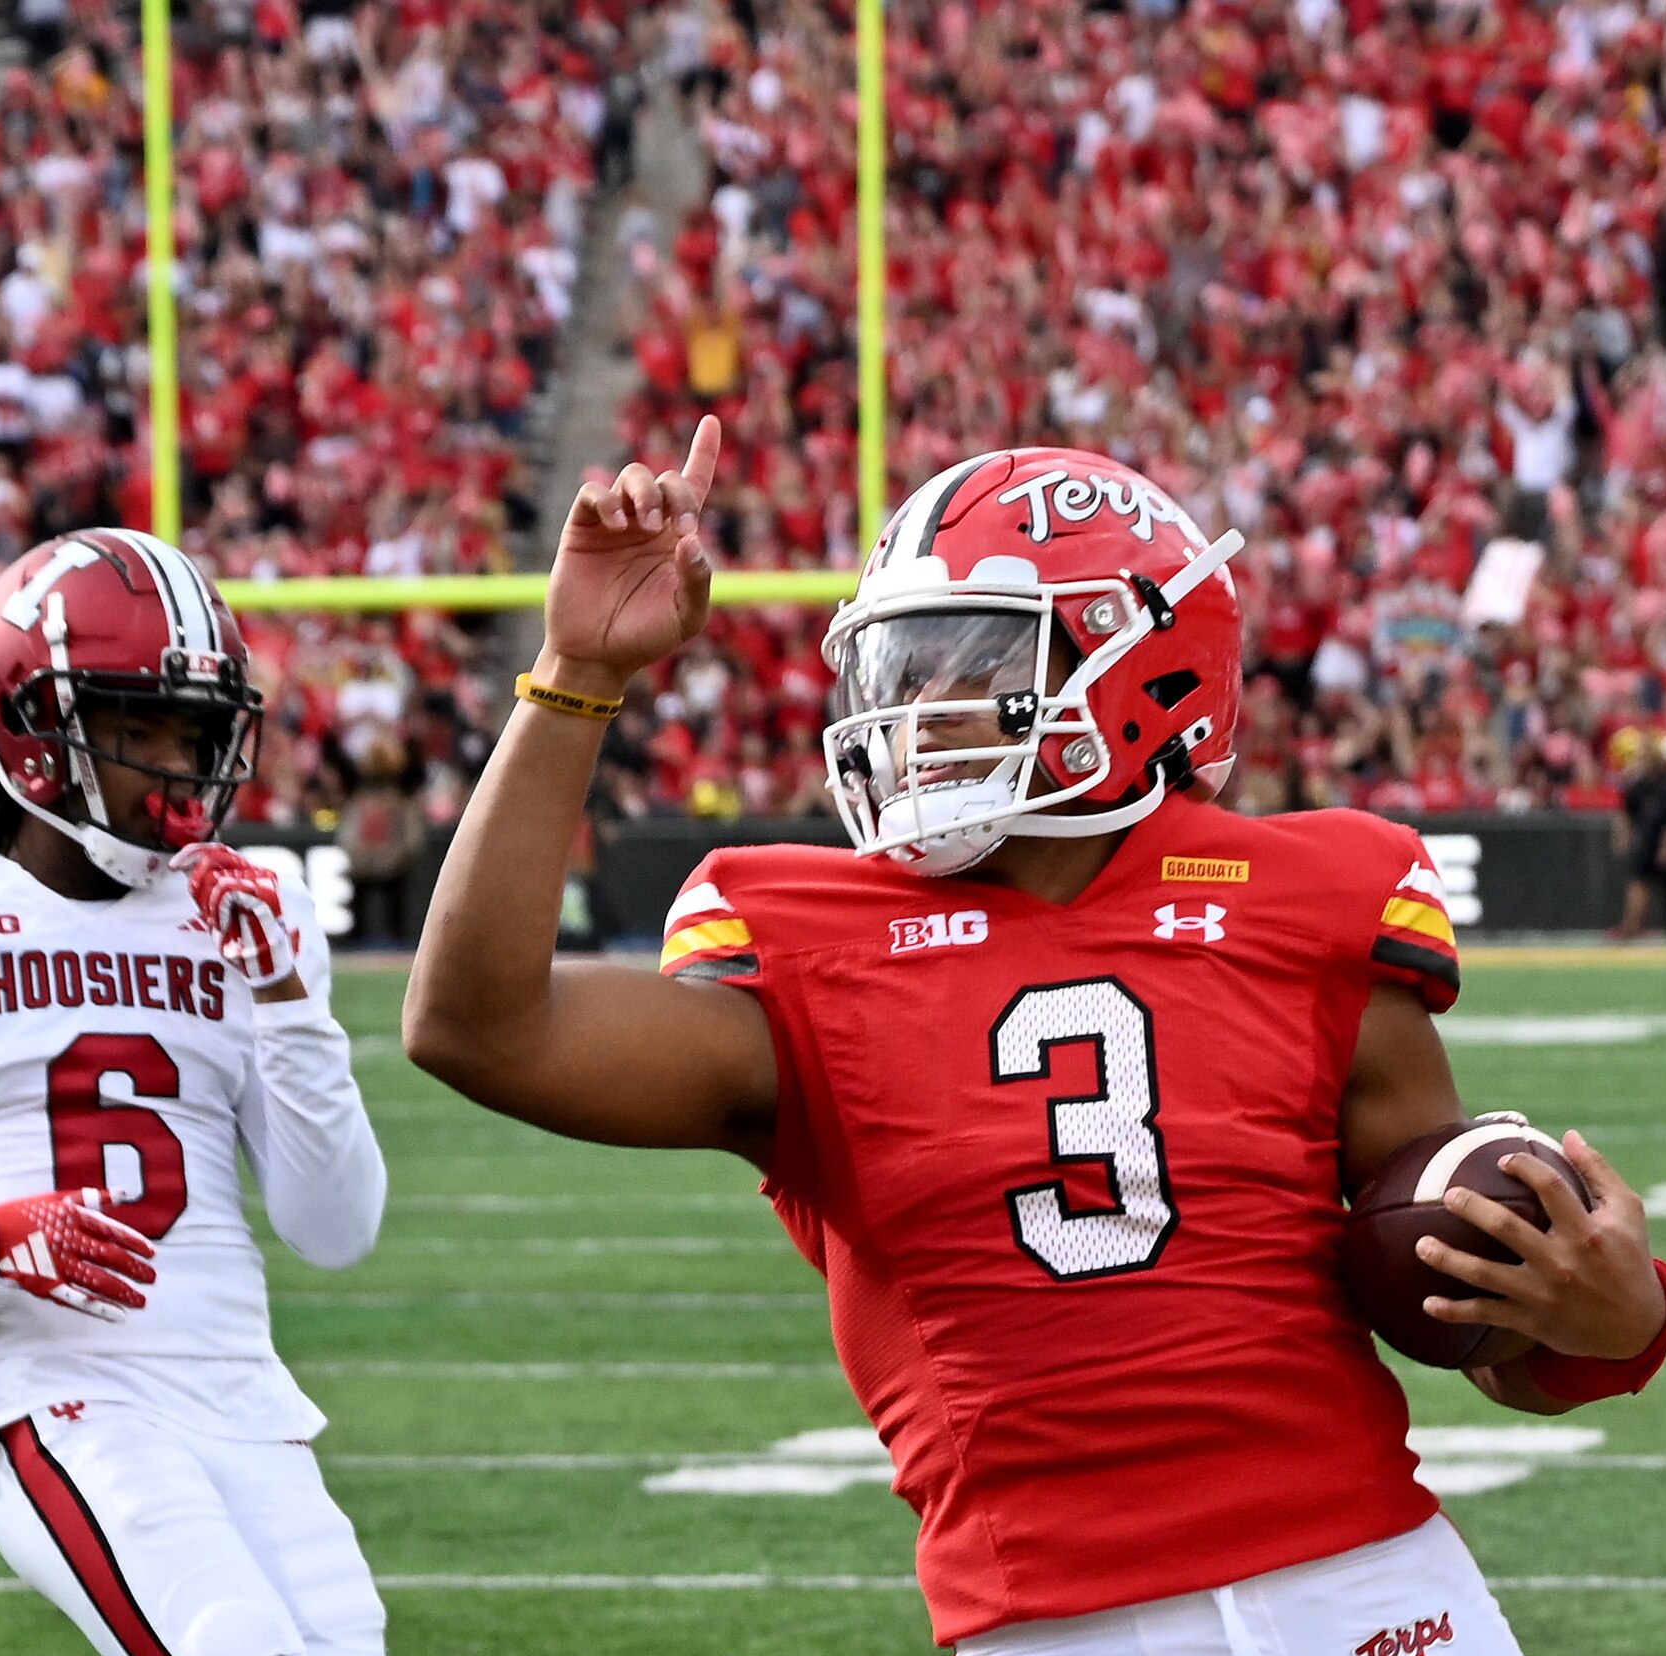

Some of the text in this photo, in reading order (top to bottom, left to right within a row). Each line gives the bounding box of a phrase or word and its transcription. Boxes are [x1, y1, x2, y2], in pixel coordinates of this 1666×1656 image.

[1166, 860, 1244, 879] GRADUATE
[46, 1033, 188, 1241] 6
[988, 975, 1180, 1282] 3
